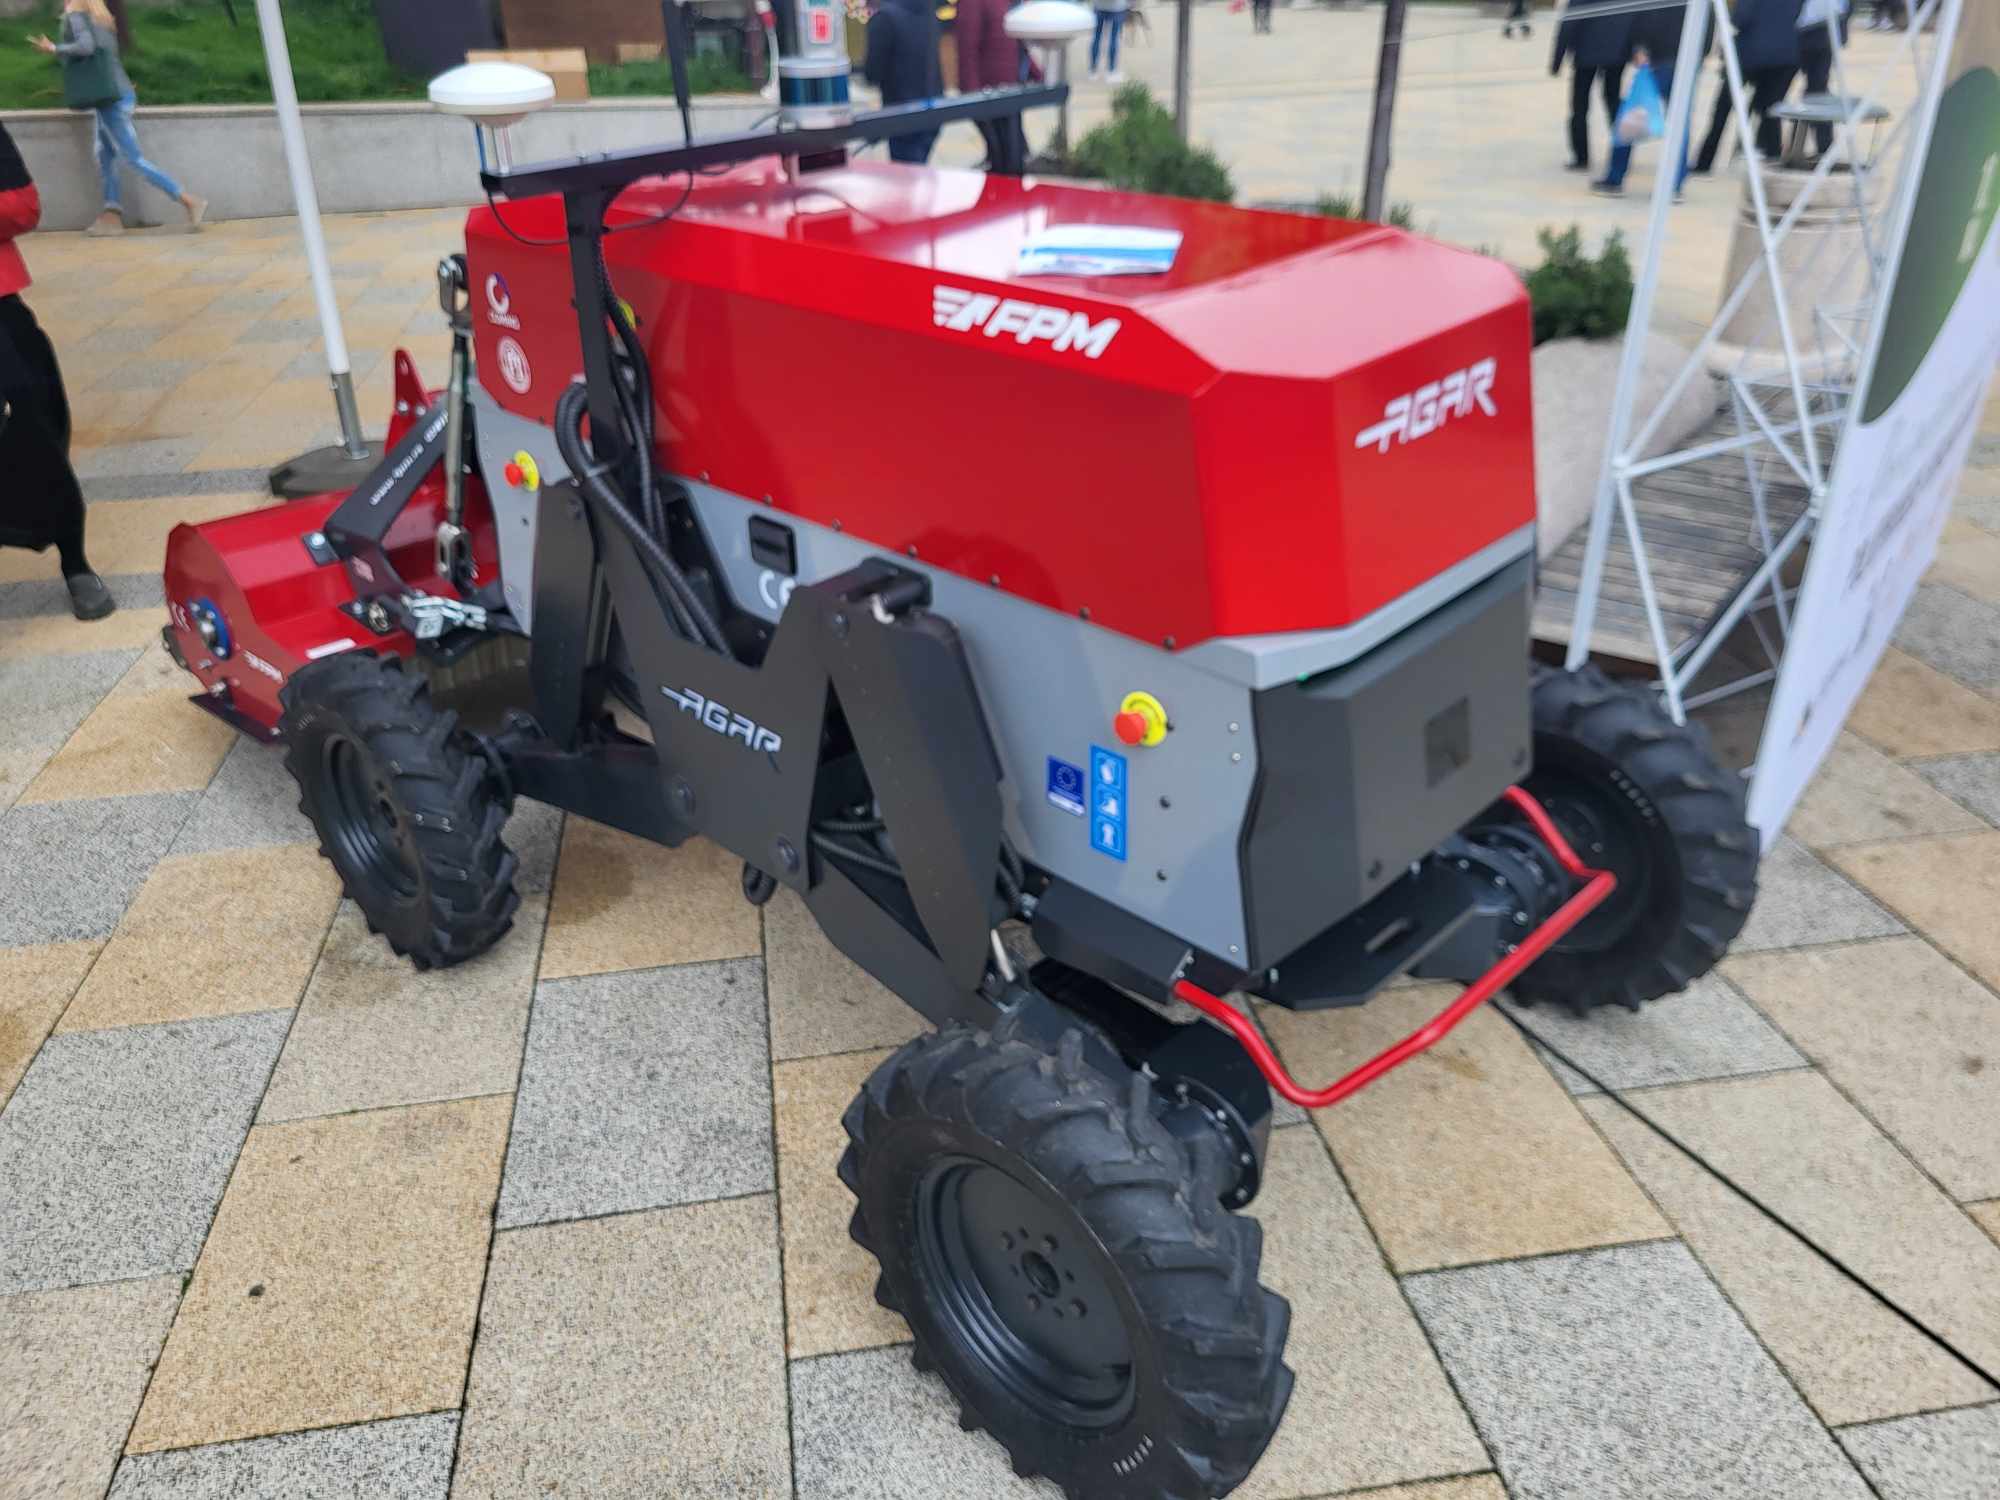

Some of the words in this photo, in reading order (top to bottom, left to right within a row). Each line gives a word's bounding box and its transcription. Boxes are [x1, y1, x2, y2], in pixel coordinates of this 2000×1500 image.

[982, 297, 1123, 360] FPM
[1354, 356, 1498, 455] AGAR
[660, 685, 782, 753] AGAR
